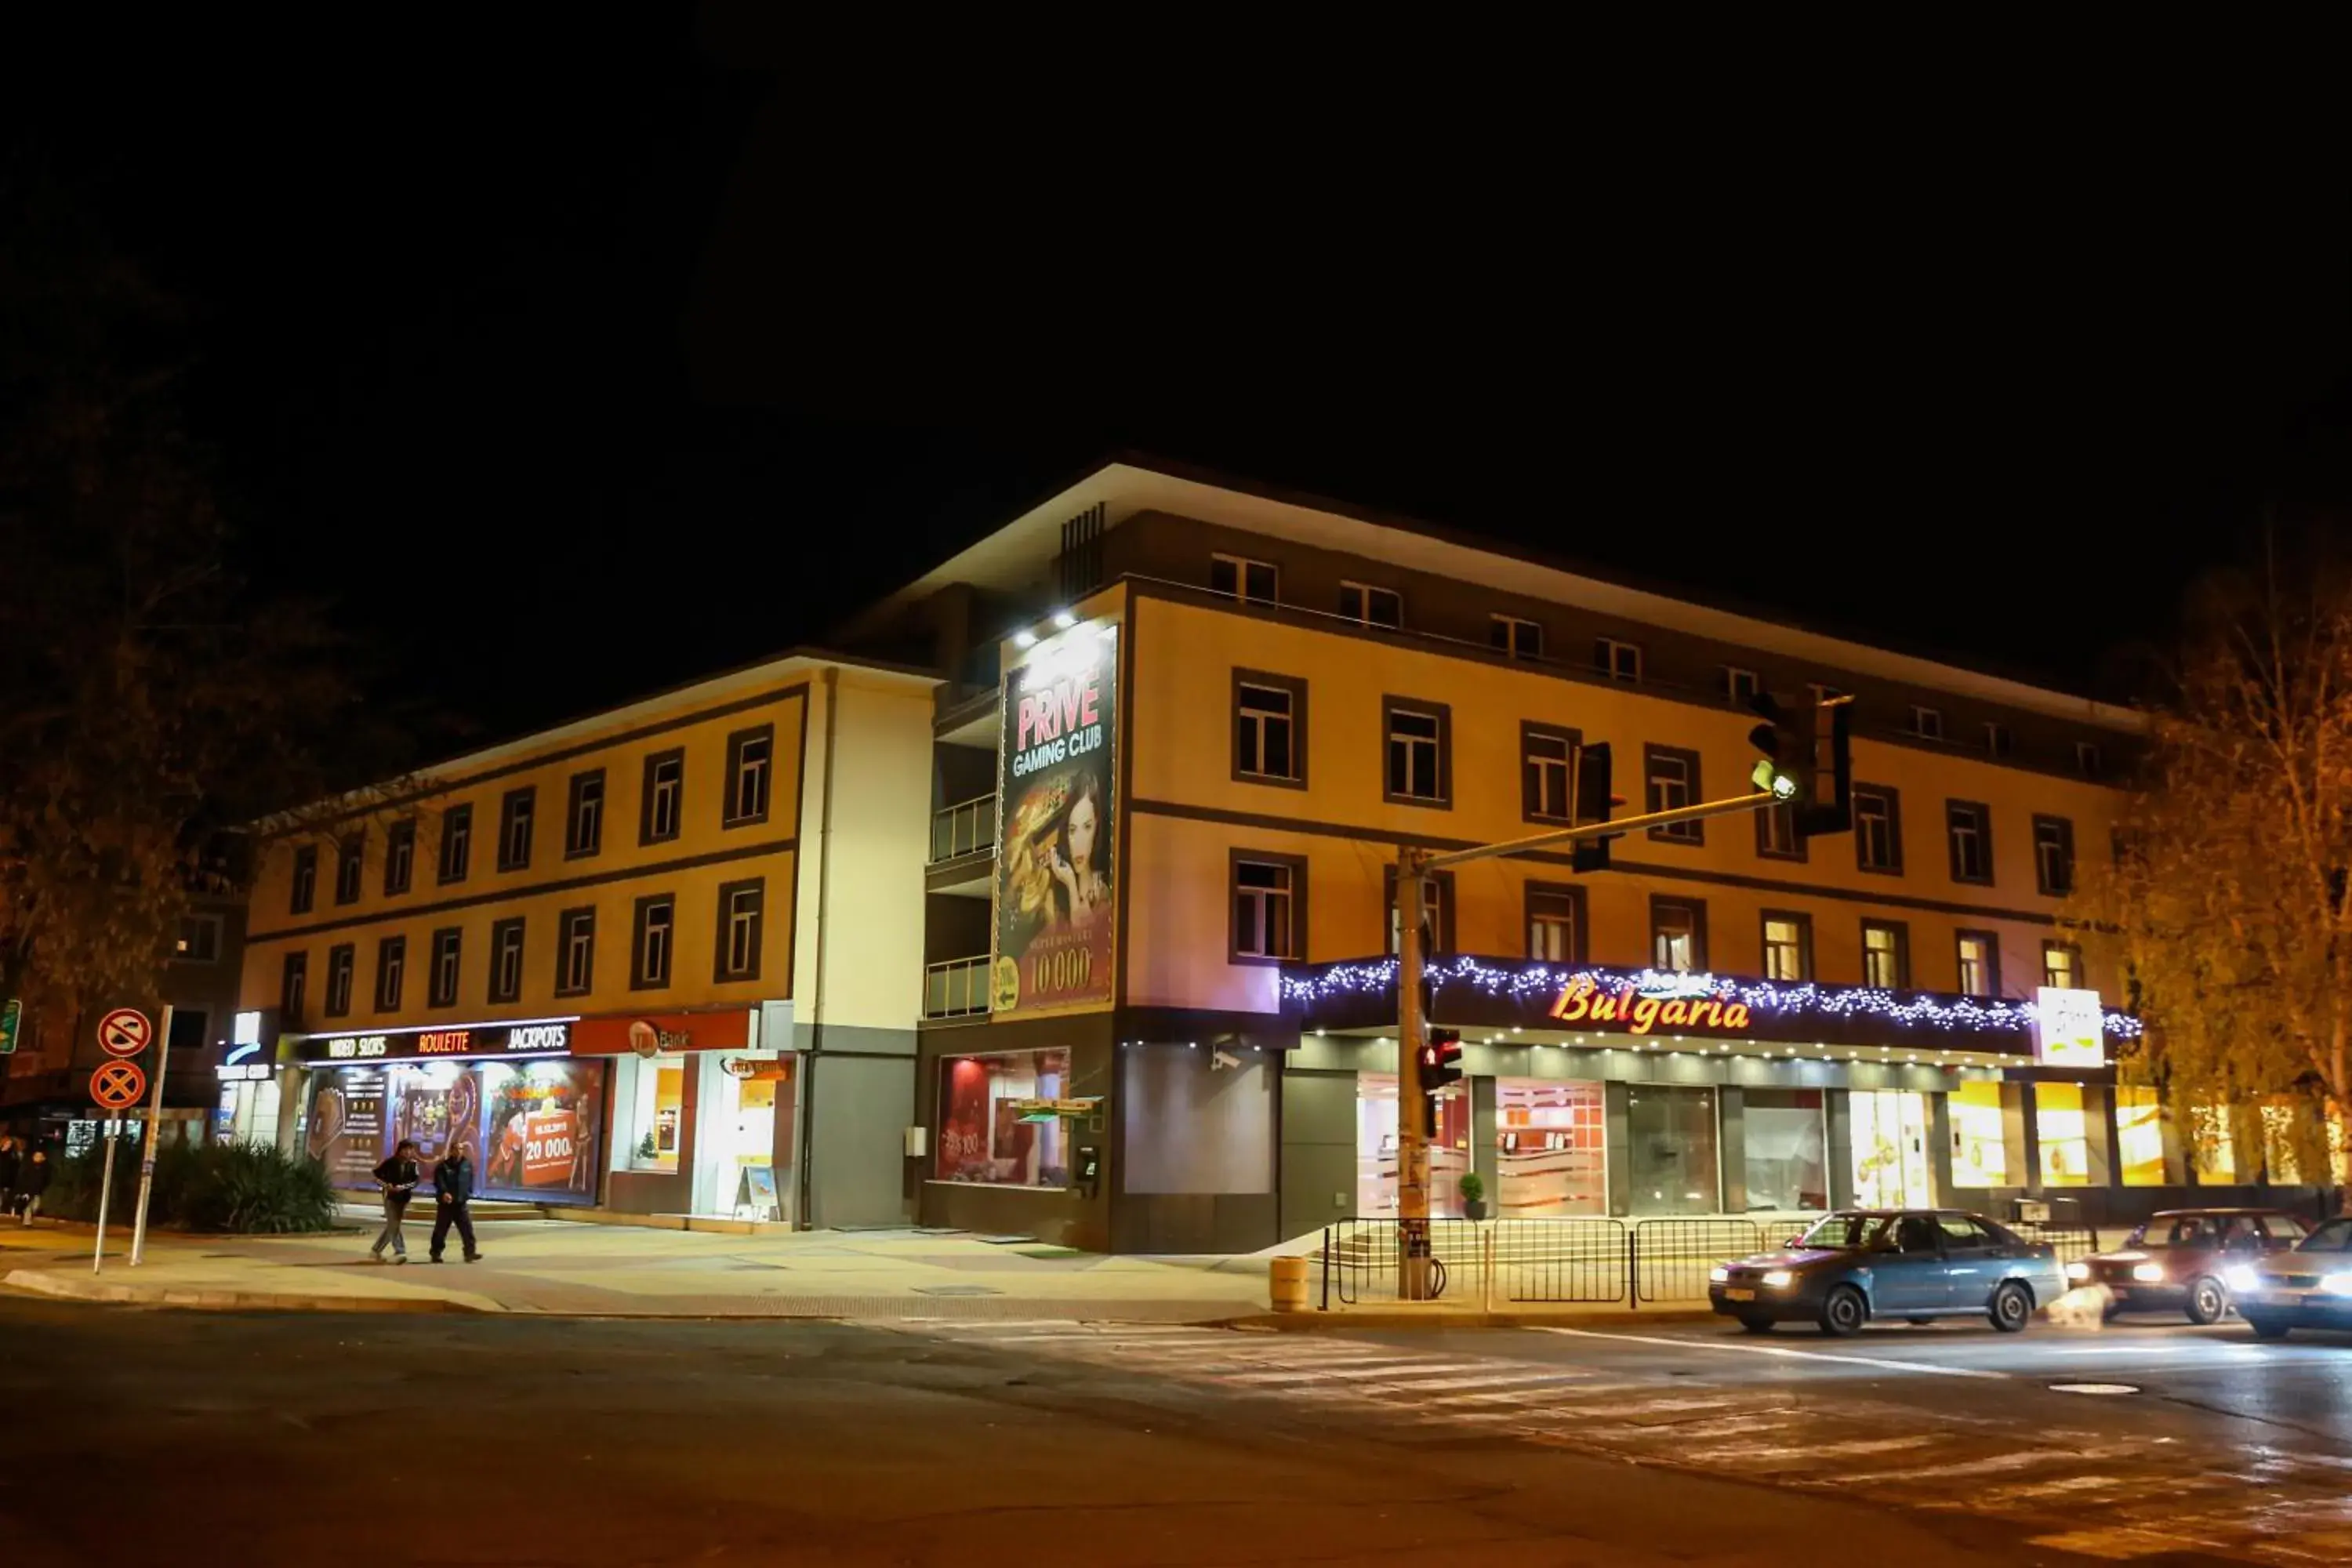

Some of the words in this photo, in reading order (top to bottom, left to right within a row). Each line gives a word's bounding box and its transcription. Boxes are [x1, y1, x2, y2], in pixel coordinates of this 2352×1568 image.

[1014, 739, 1065, 776] GAMING
[1069, 724, 1102, 757] CLUB
[1548, 975, 1750, 1035] Bulgaria
[358, 1036, 387, 1056] SLOTS
[419, 1031, 470, 1053] ROULETTE
[509, 1025, 565, 1049] JACKPOTS
[659, 1029, 690, 1047] Bank
[526, 1140, 542, 1161] 20
[545, 1136, 570, 1158] 000
